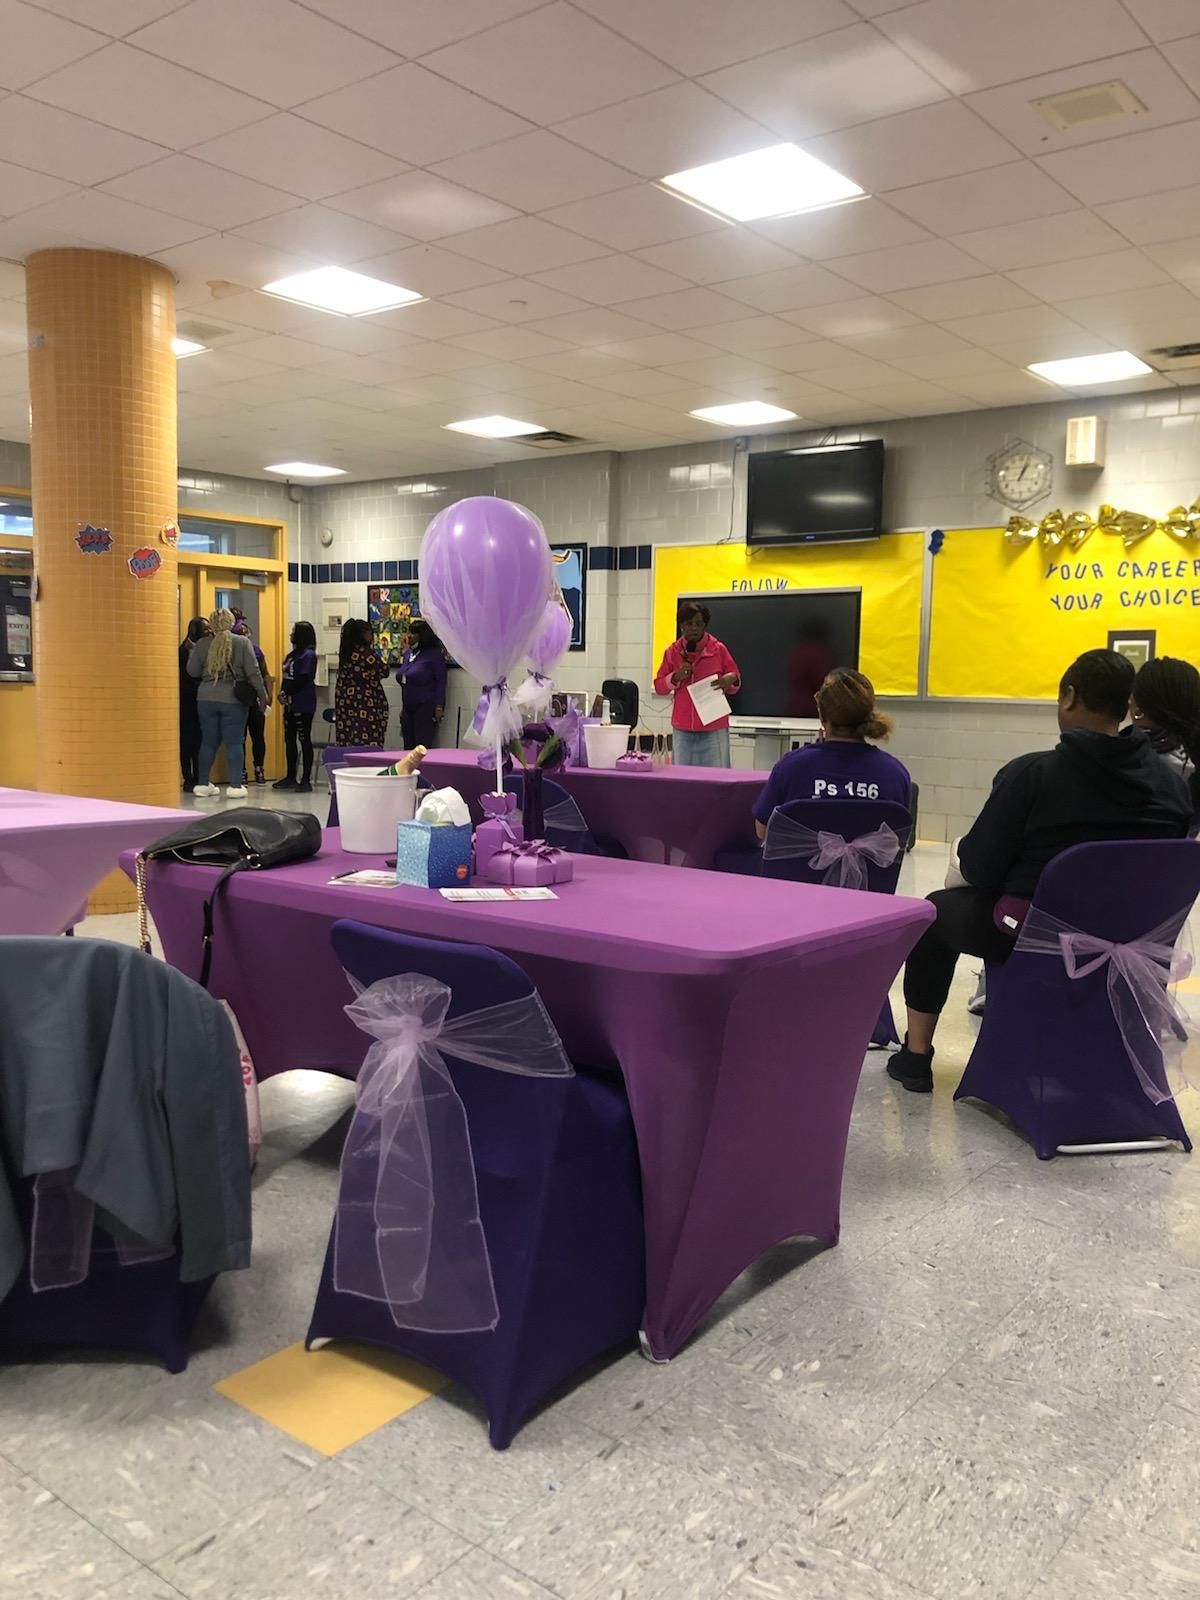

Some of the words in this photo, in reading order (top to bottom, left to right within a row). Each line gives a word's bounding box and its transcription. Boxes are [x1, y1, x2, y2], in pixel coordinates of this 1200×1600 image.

[1045, 562, 1104, 580] YOUR
[1050, 593, 1103, 611] YOUR
[1119, 588, 1200, 607] CHOICE
[814, 779, 838, 796] Ps
[844, 781, 879, 800] 156
